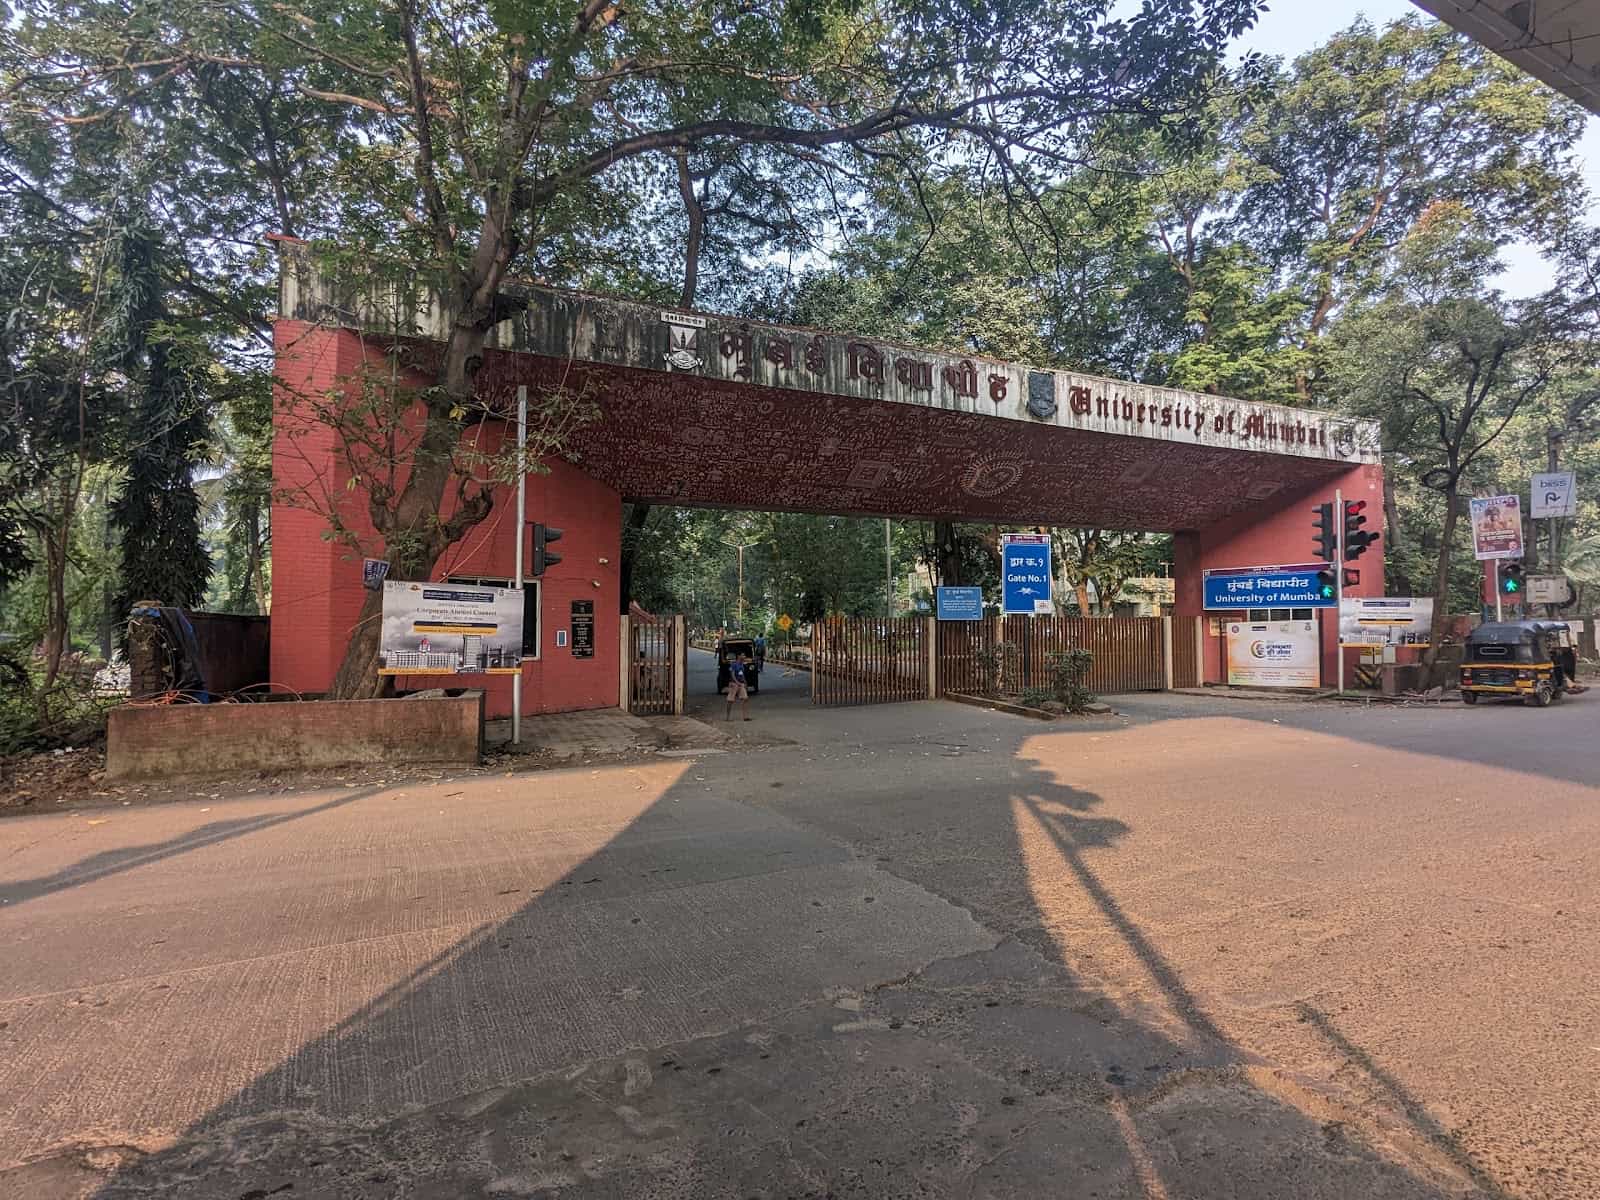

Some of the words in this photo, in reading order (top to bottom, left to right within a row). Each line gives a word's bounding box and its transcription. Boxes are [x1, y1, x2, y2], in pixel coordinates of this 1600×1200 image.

[848, 341, 1009, 403] विद्यापीठ
[1070, 386, 1204, 437] University
[1214, 410, 1235, 434] of
[1241, 413, 1325, 446] Mumbai
[1007, 574, 1027, 583] Gate
[1028, 574, 1042, 583] No.
[1226, 579, 1253, 592] मुंबई
[1256, 576, 1310, 589] विद्यापीठ
[1215, 593, 1265, 604] University
[1266, 592, 1278, 603] of
[1279, 590, 1321, 602] Mumba
